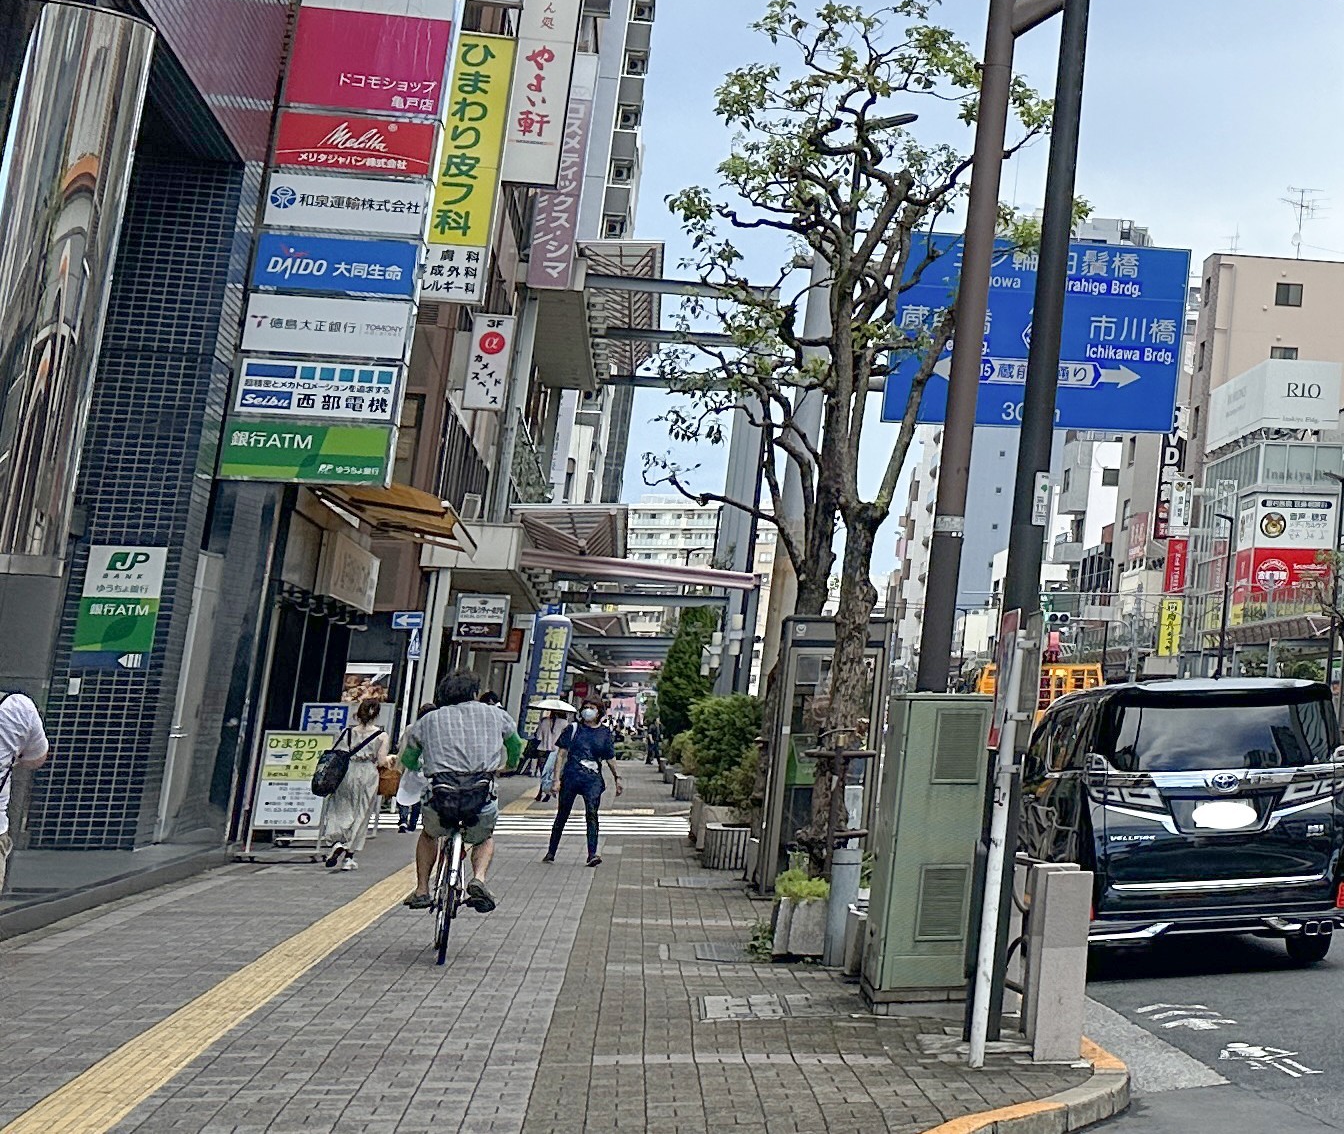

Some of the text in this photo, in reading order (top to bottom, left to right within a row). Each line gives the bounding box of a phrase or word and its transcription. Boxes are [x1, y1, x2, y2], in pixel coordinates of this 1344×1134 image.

[339, 72, 437, 94] ドコモショップ
[517, 45, 556, 138] やよい軒
[391, 96, 434, 112] 亀戸店
[318, 122, 389, 153] Melitta
[433, 42, 496, 237] ひまわり皮フ科
[298, 152, 408, 170] メリタジャパン株式会社
[299, 193, 421, 214] 和泉運輸株式会社
[267, 255, 326, 279] DAIDO
[333, 261, 404, 281] 大同生命
[1111, 280, 1141, 297] Brdg.
[269, 318, 356, 334] 徳島大正銀行
[486, 319, 504, 328] 3F
[1090, 316, 1176, 345] 市川橋
[1086, 344, 1174, 365] Ichikawa Brdg.
[1286, 382, 1322, 398] RIO
[242, 393, 388, 414] Seibu 西部電機
[231, 430, 312, 450] 銀行ATM
[336, 466, 379, 475] ゆうちょ銀行
[106, 551, 150, 571] JP
[95, 584, 149, 594] ゆうちょ銀行
[89, 603, 149, 617] 銀行ATM
[269, 738, 318, 749] ひまわり
